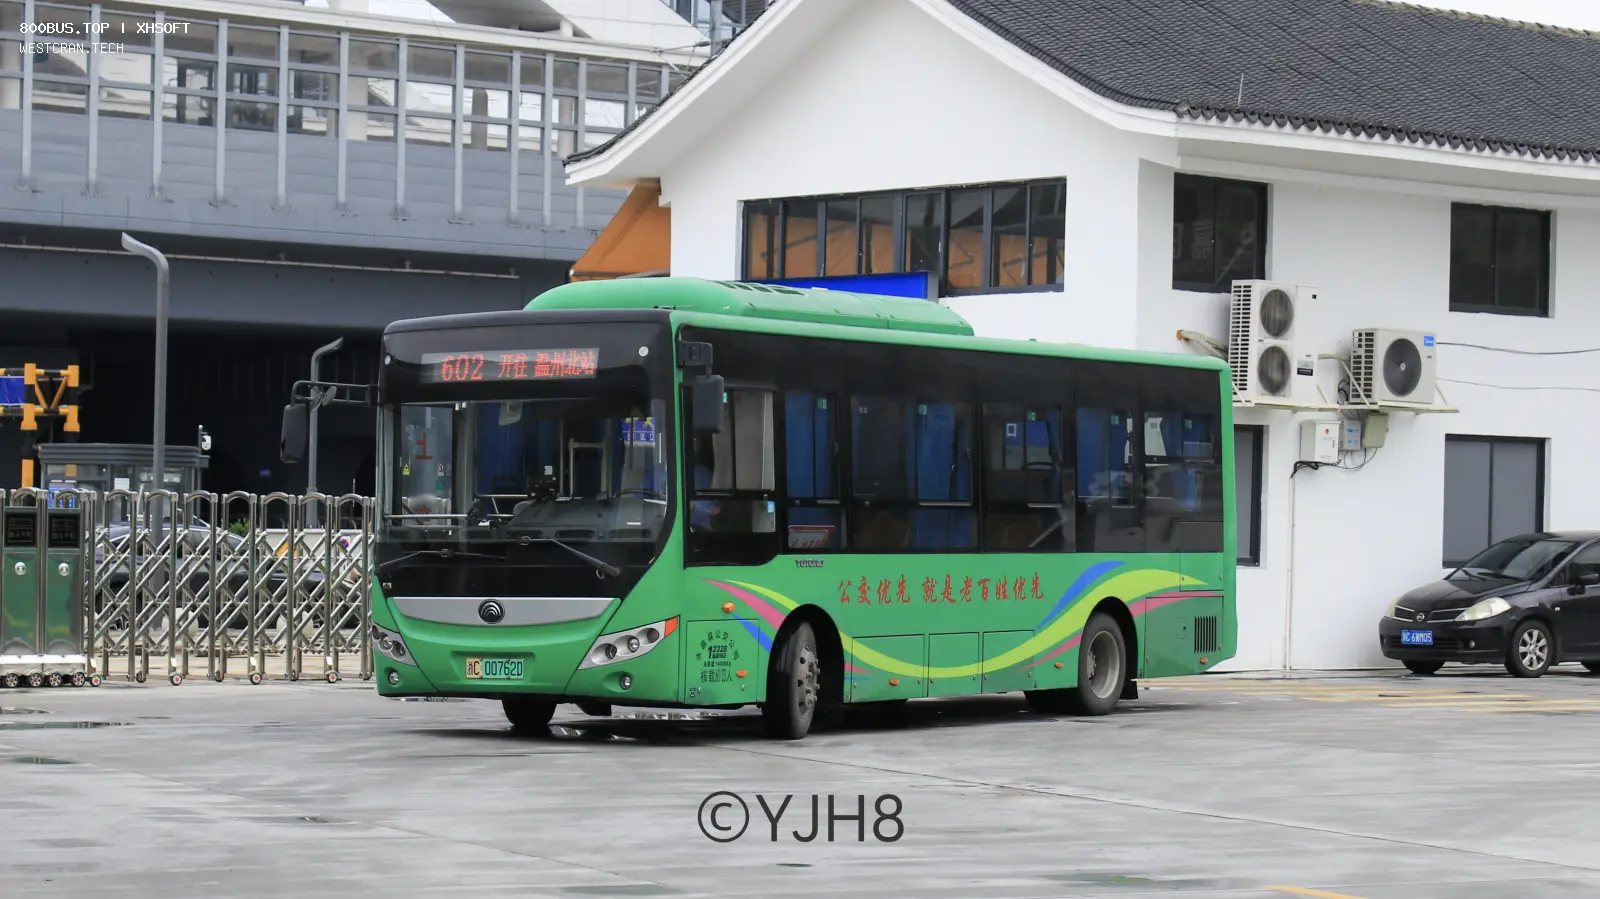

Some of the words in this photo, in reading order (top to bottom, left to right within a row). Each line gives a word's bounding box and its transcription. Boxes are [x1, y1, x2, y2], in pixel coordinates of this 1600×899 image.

[442, 354, 484, 381] 602
[837, 573, 911, 606] 公交优先
